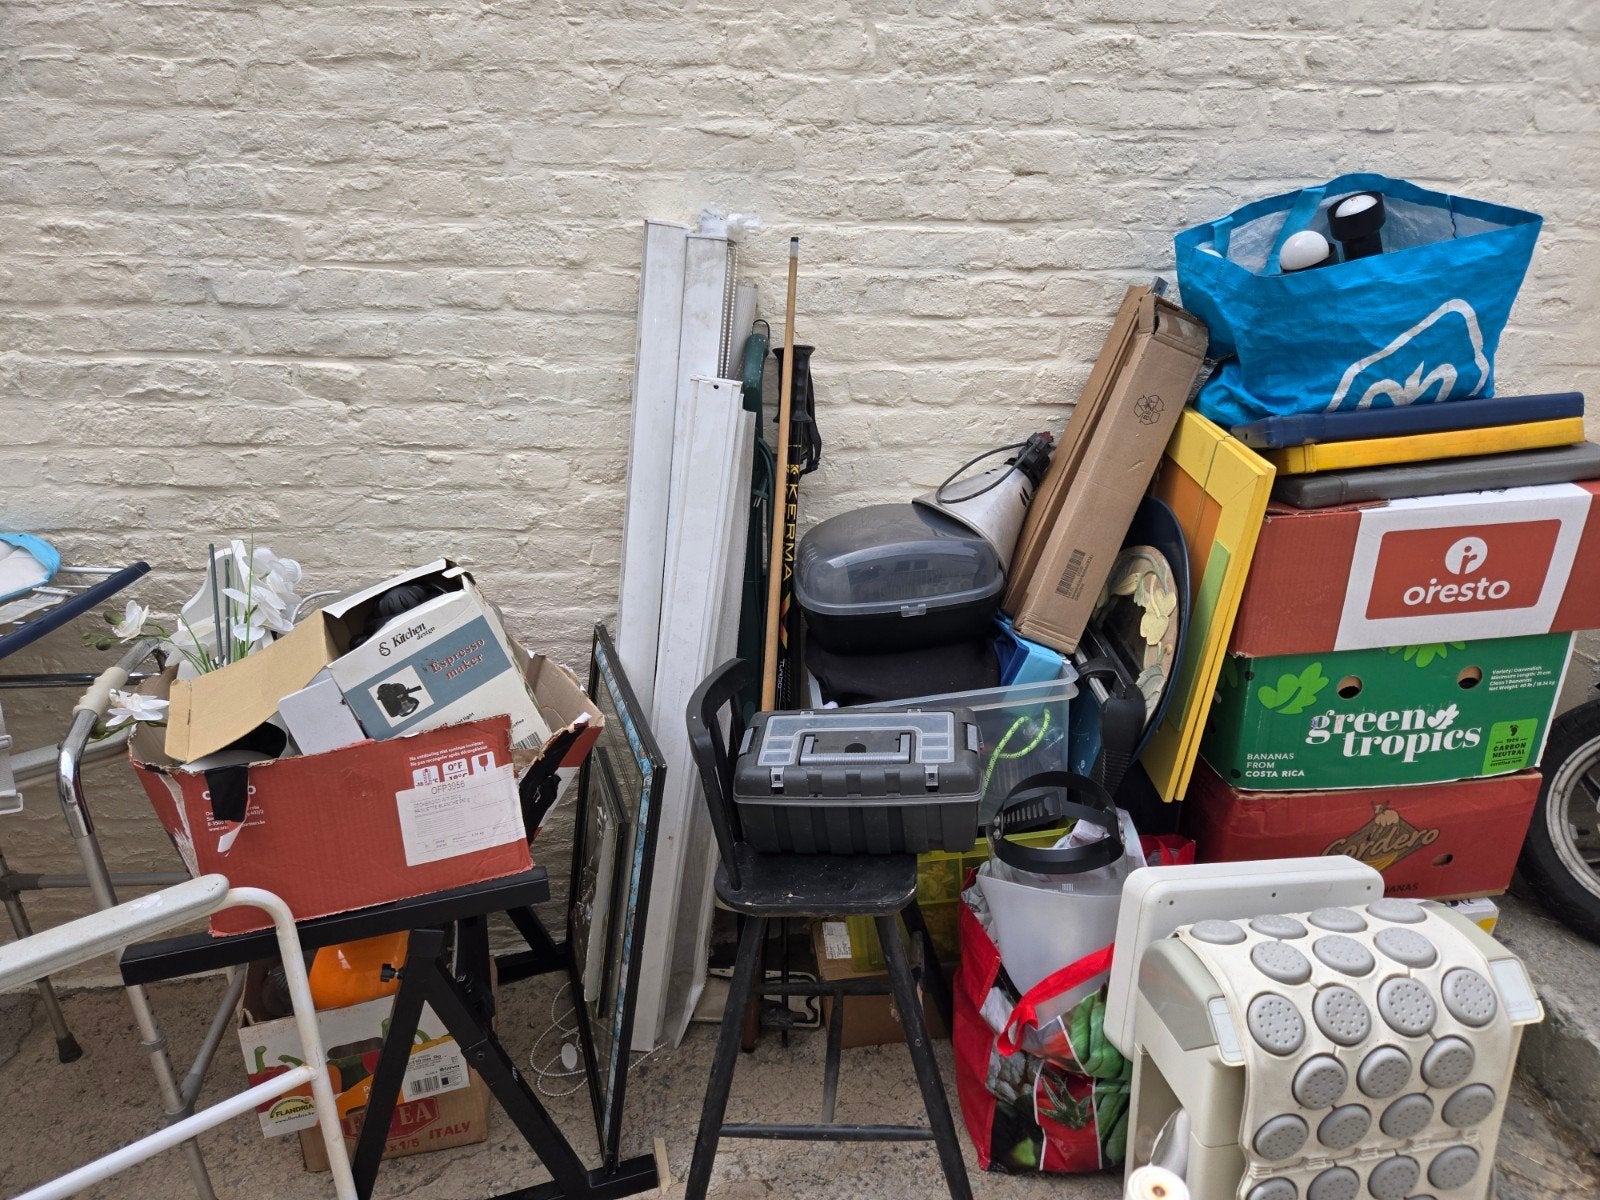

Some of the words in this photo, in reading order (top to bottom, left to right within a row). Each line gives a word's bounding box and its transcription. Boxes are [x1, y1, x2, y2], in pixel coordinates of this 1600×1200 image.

[783, 483, 798, 581] KERMA
[391, 622, 426, 648] Kitchen
[416, 626, 436, 641] design
[429, 638, 485, 674] Espresso
[445, 653, 483, 680] maker
[1305, 708, 1426, 745] green
[1341, 727, 1482, 763] tropics
[1492, 748, 1526, 758] NEUTRAL
[1493, 742, 1527, 752] CARBON
[1246, 752, 1295, 761] BANANAS
[1246, 761, 1275, 769] FROM
[1245, 770, 1278, 778] COSTA
[1281, 769, 1305, 778] RICA
[1321, 826, 1440, 860] Cordero
[275, 1103, 314, 1118] FLANDRIA
[429, 1121, 470, 1140] ITALY
